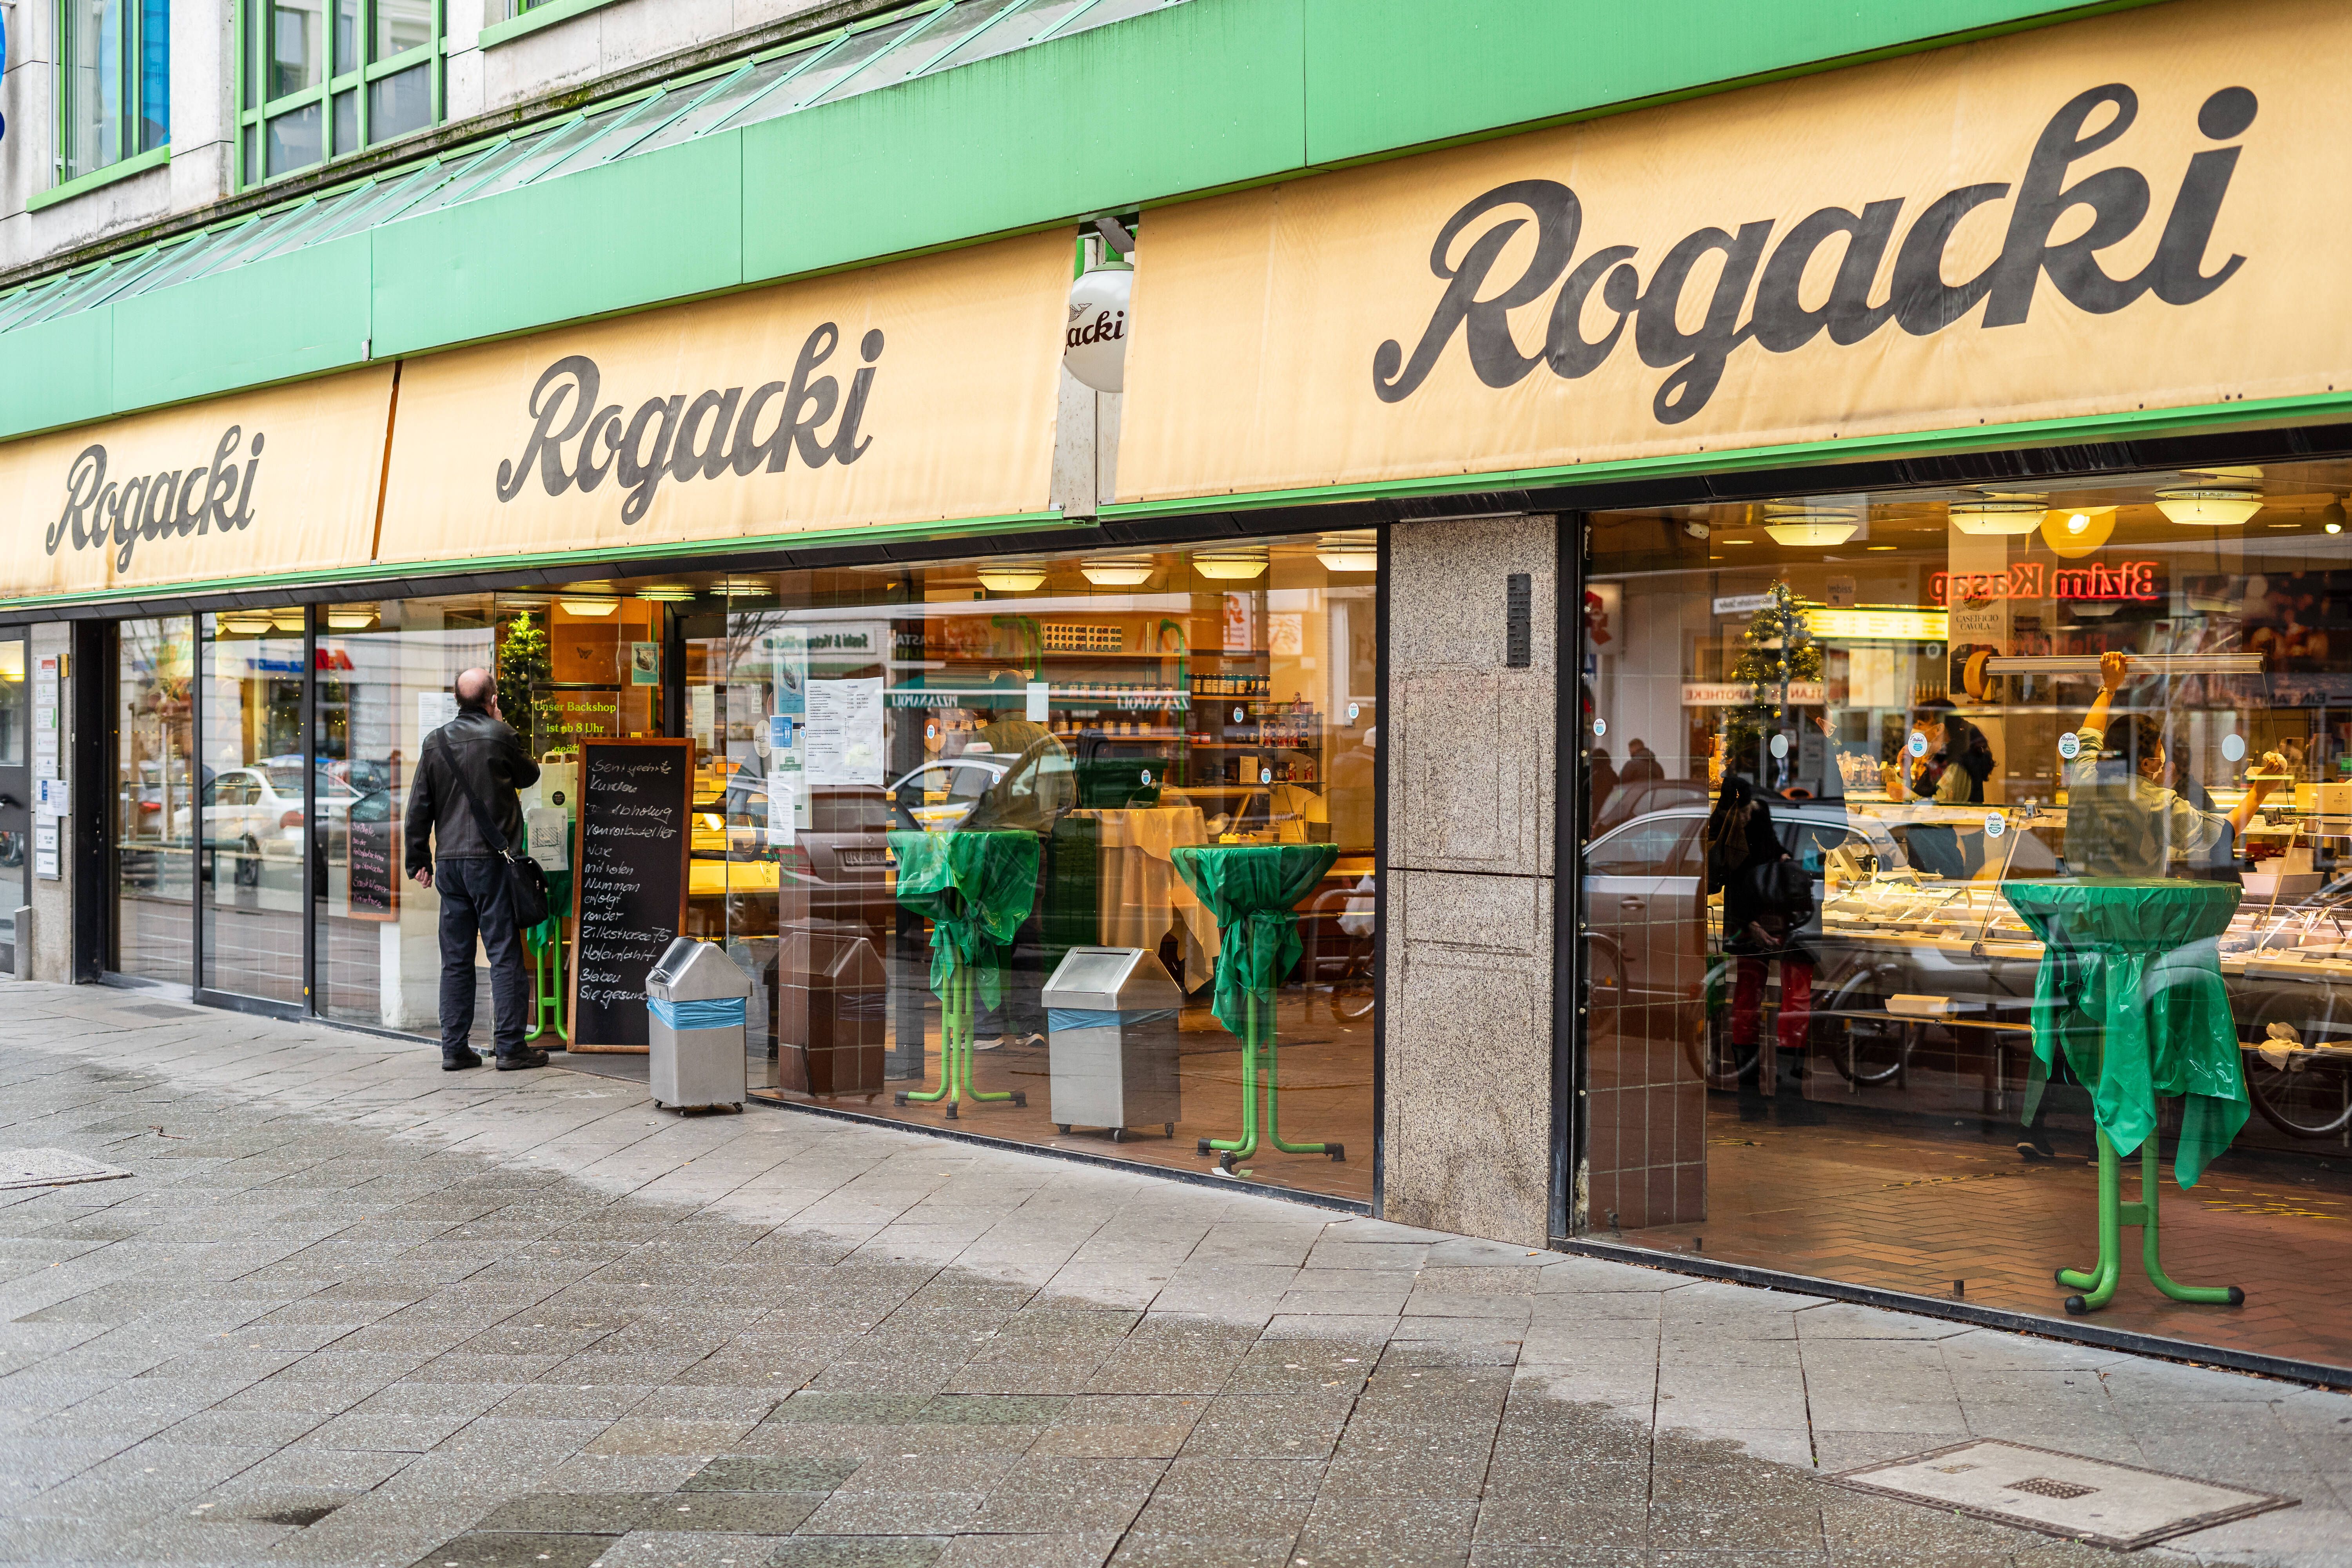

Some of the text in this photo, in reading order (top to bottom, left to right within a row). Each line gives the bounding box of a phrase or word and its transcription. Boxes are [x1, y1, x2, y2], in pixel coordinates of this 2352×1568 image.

[1373, 83, 2258, 425] Rogacki
[1064, 310, 1124, 356] acki
[497, 322, 884, 525] Rogacki
[46, 425, 264, 573] Rogacki
[1956, 614, 1998, 623] CASEIFICIO
[534, 701, 616, 713] Unser Backshop
[546, 723, 604, 733] ist ab 8 Uhr
[590, 774, 638, 793] Kunden
[584, 891, 622, 910] erfolgt
[652, 926, 672, 943] 75
[580, 985, 601, 1000] Sie
